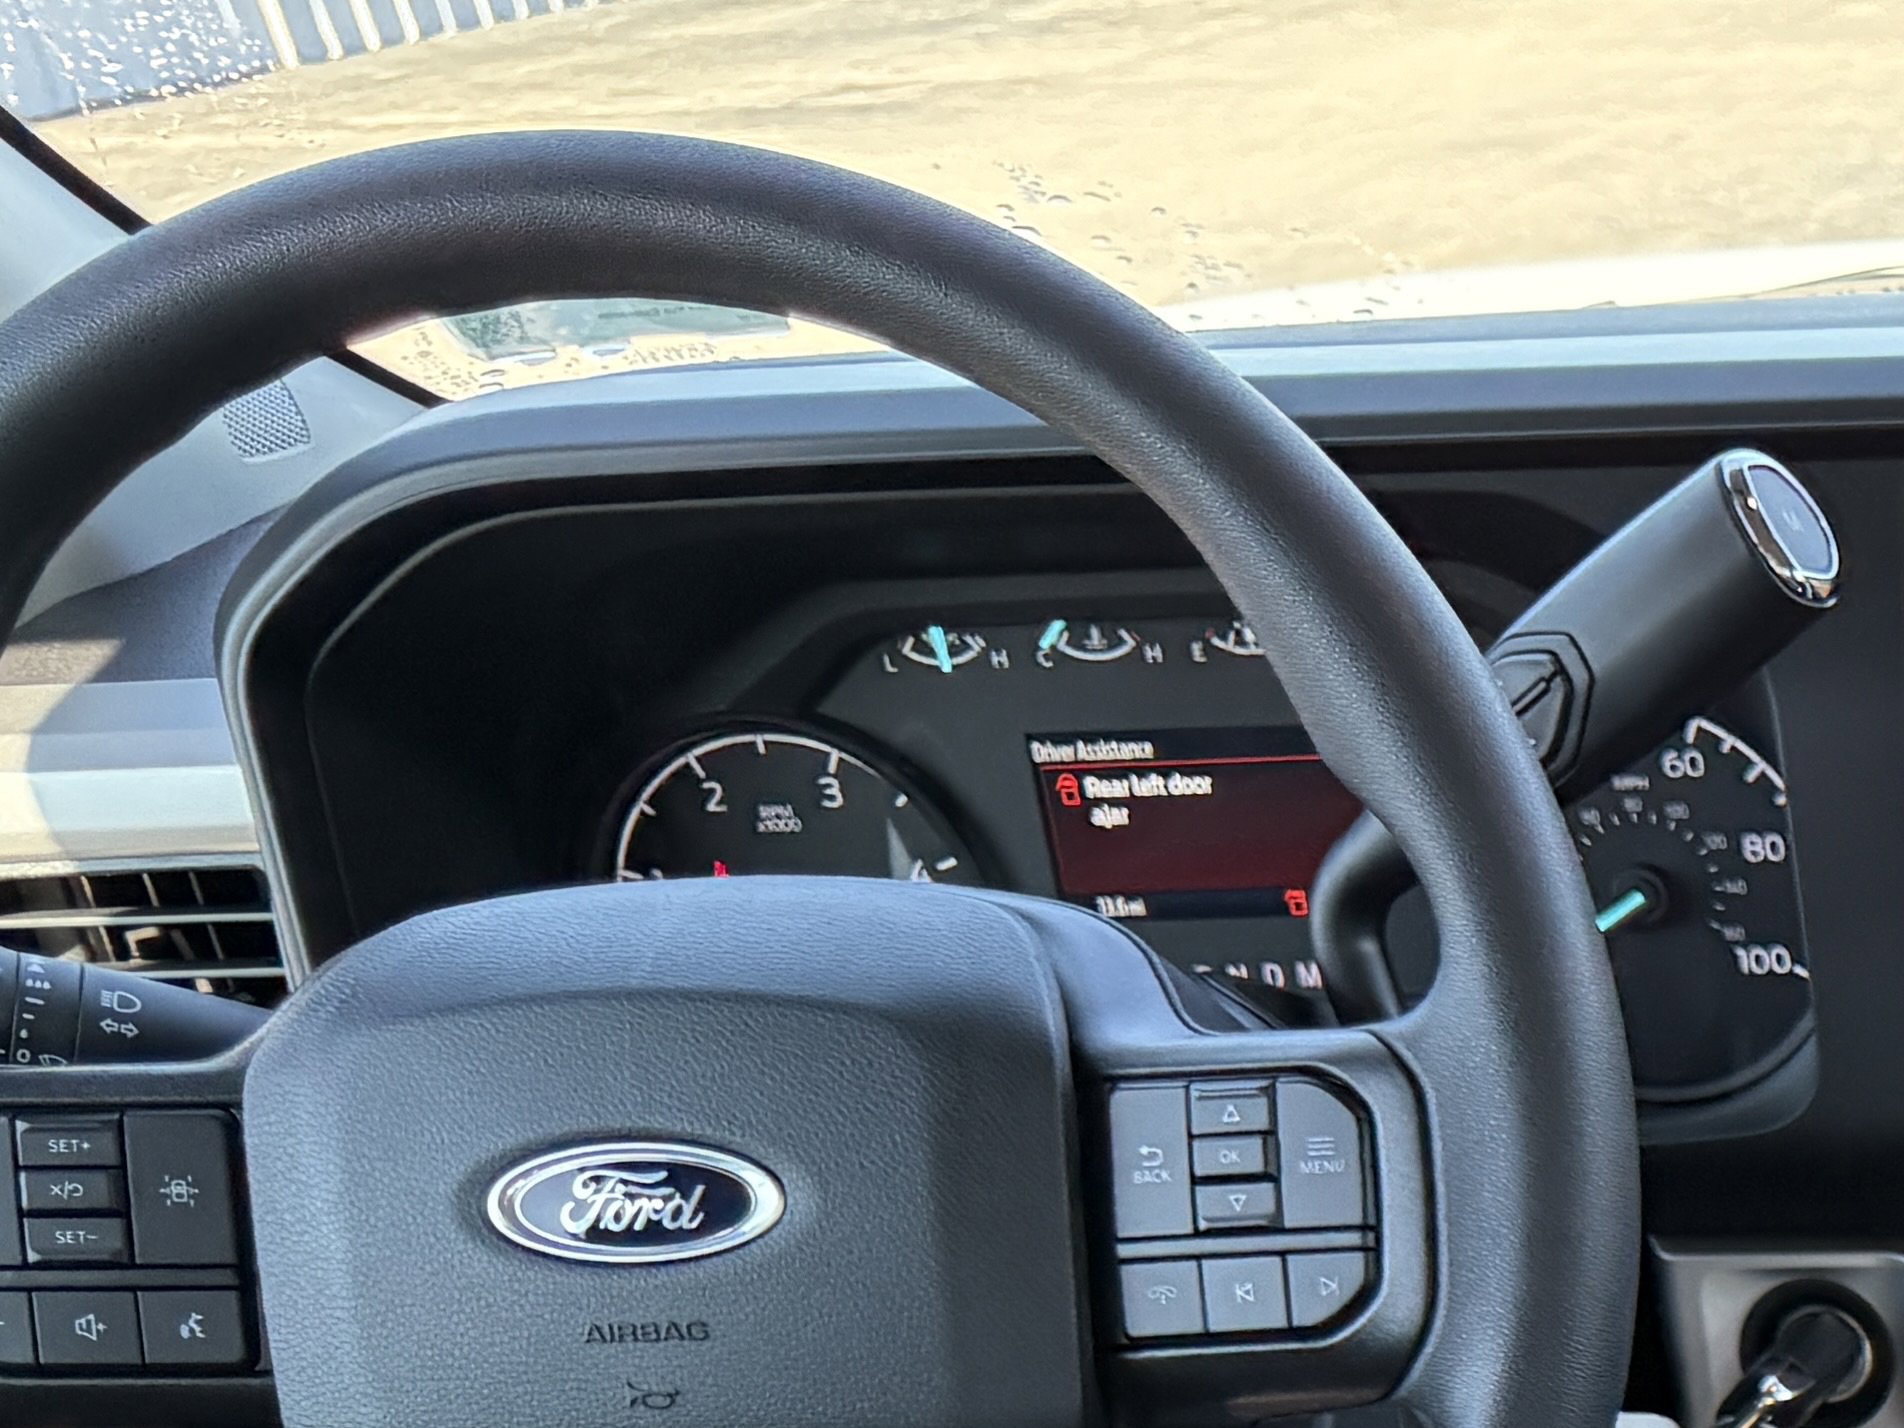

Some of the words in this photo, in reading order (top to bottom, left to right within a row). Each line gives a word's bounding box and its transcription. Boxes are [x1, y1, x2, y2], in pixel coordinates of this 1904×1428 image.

[990, 649, 1009, 668] H
[1142, 643, 1164, 663] H
[1030, 740, 1075, 763] Driver
[1076, 739, 1154, 761] Assistance
[1660, 748, 1705, 778] 60
[700, 781, 728, 812] 2
[816, 776, 843, 808] 3
[1082, 775, 1130, 799] Rear
[1129, 772, 1168, 796] left
[1167, 771, 1212, 796] door
[1089, 803, 1130, 829] ajar
[1740, 832, 1786, 863] 80
[1731, 944, 1792, 975] 100
[1294, 960, 1323, 989] M
[48, 1139, 91, 1153] SET+
[1219, 1150, 1241, 1164] OK
[1132, 1170, 1173, 1184] BACK
[1300, 1160, 1346, 1174] MENU
[560, 1169, 706, 1239] Ford
[584, 1321, 710, 1344] AIRBAG
